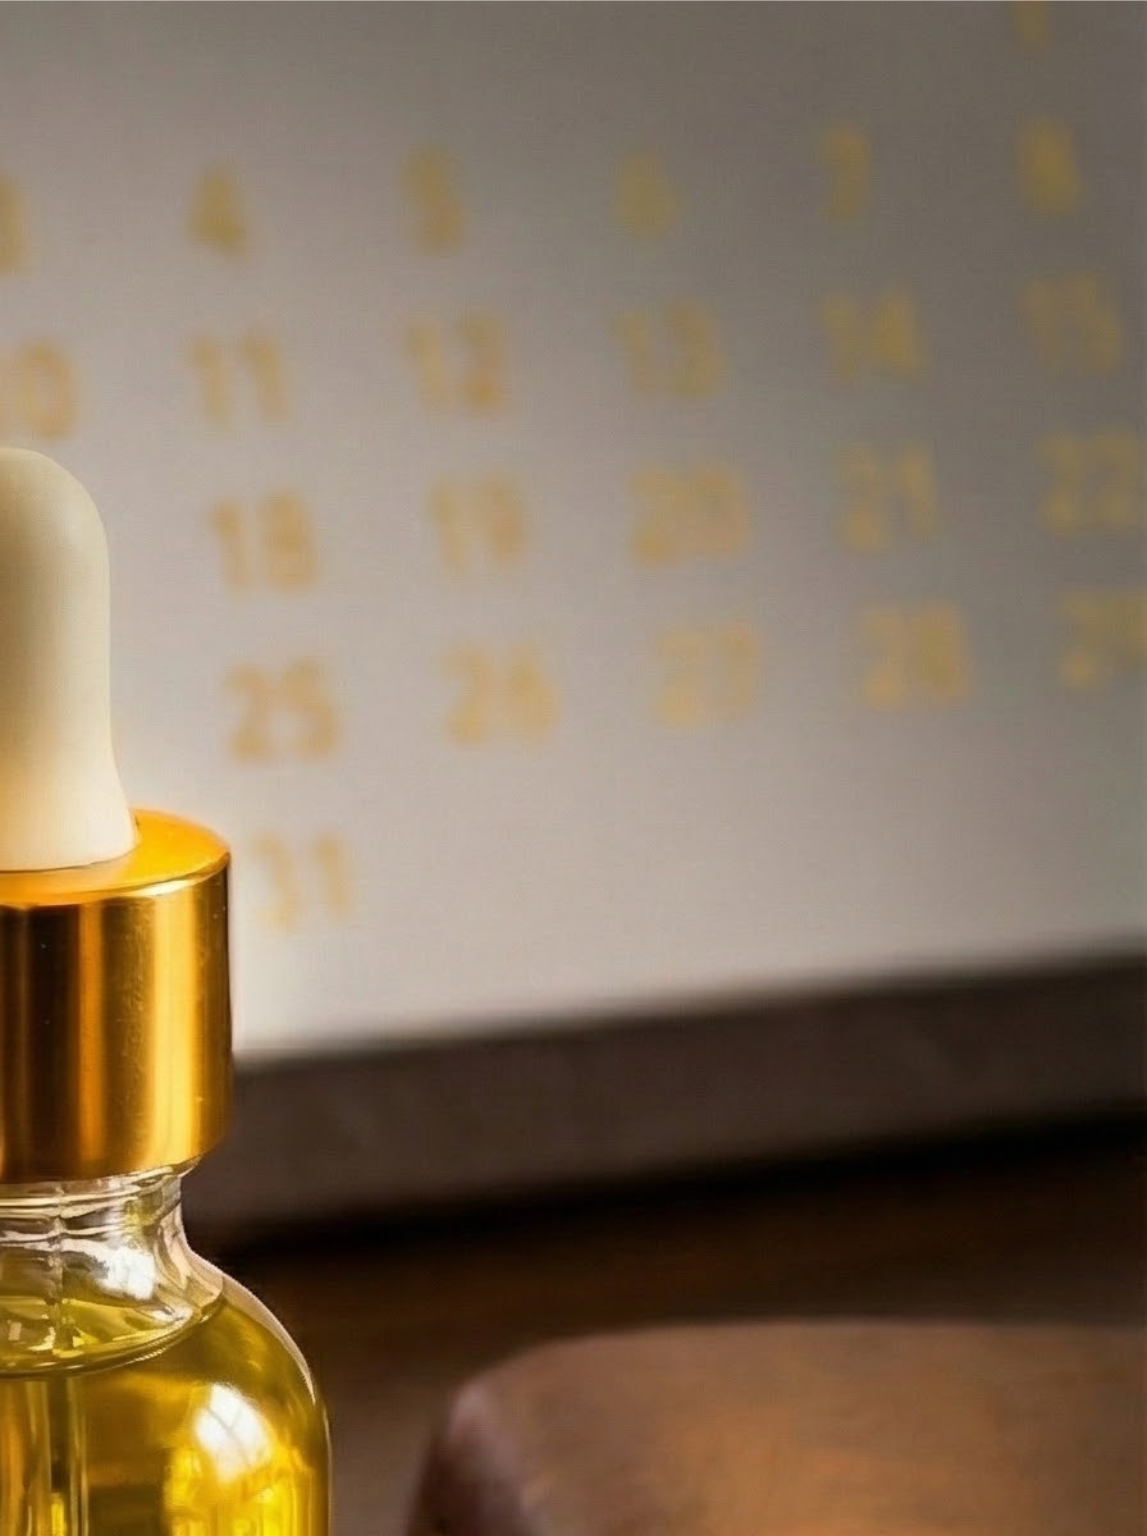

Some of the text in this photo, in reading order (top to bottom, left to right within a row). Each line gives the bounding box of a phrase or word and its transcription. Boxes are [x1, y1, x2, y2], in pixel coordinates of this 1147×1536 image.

[186, 330, 291, 428] 11
[403, 315, 510, 417] 12
[209, 489, 322, 593] 18
[227, 658, 343, 765] 25
